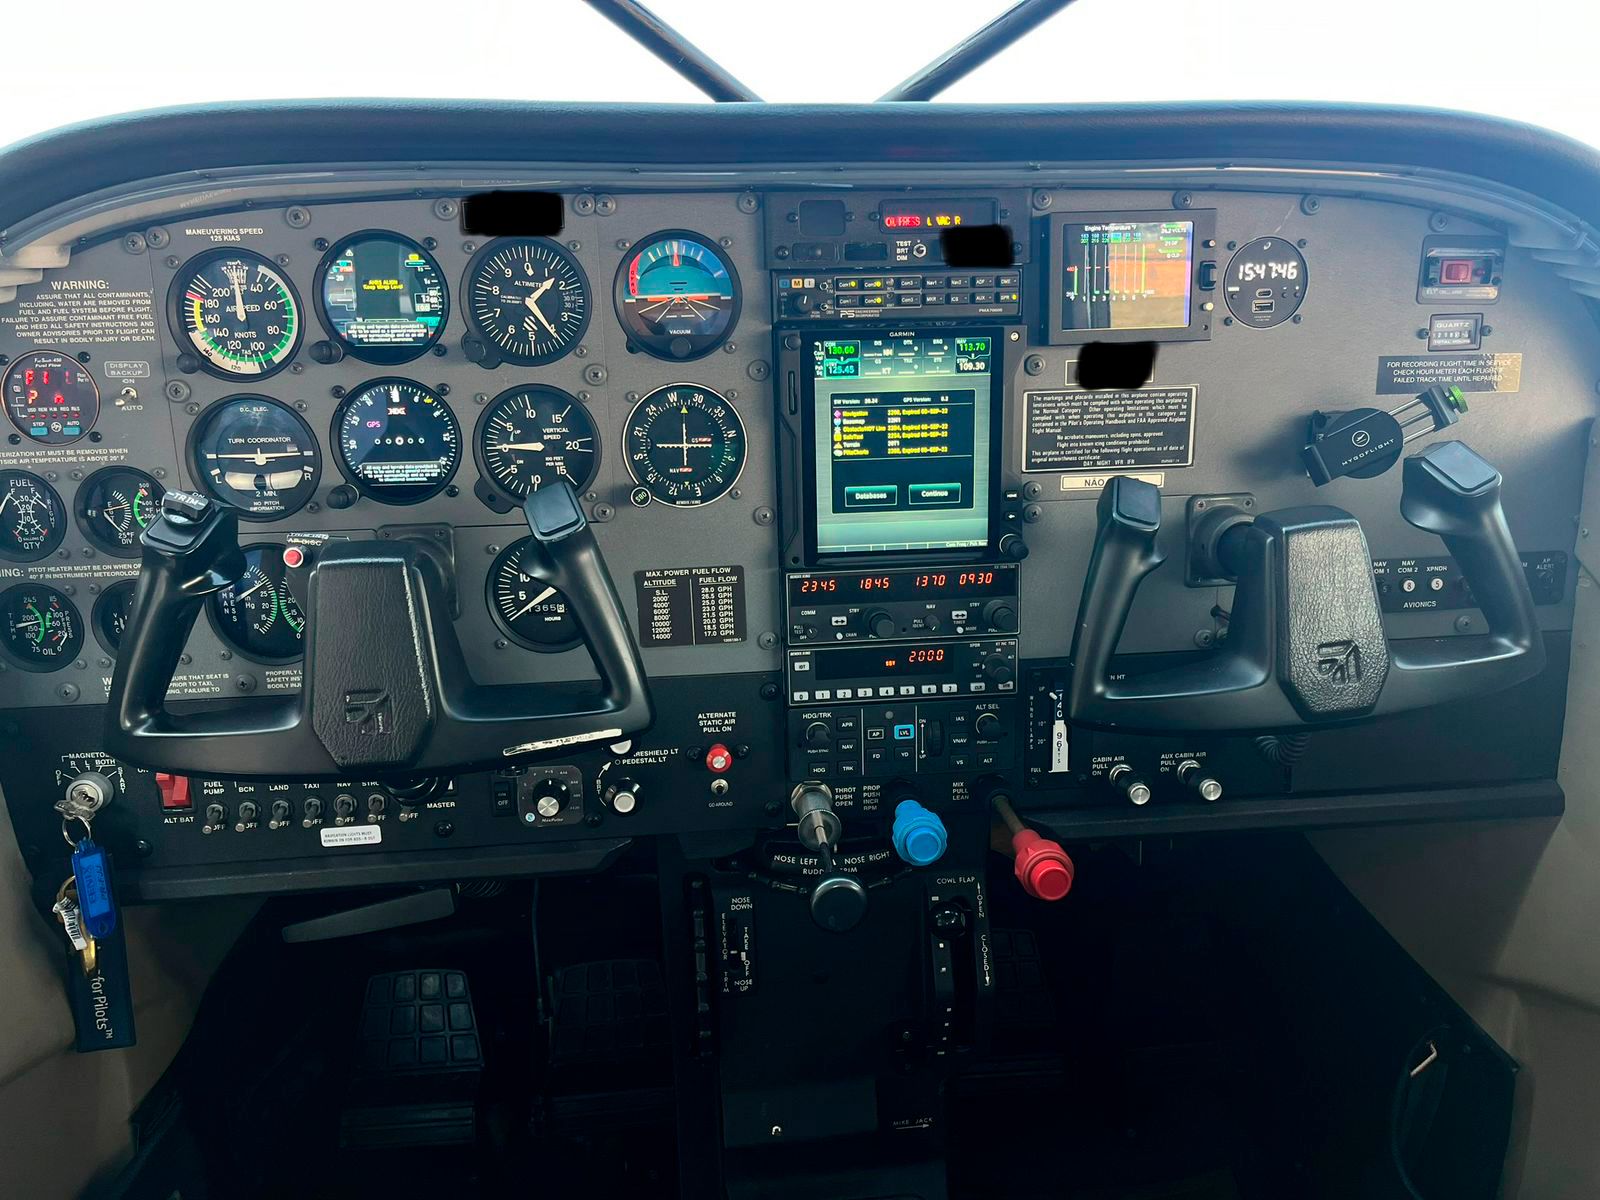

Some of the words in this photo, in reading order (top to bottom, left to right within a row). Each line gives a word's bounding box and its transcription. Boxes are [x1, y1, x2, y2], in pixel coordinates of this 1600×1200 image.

[505, 268, 512, 278] 9
[51, 280, 109, 290] WARNING:
[250, 284, 263, 292] 40
[559, 281, 566, 290] 2
[212, 288, 230, 297] 200
[492, 286, 499, 295] 8
[205, 300, 219, 308] 180
[264, 301, 277, 310] 60
[494, 309, 500, 317] 7
[561, 312, 568, 321] 3
[205, 314, 220, 323] 160
[213, 328, 229, 337] 140
[267, 326, 279, 334] 80
[508, 325, 515, 334] 6
[528, 332, 535, 340] 5
[227, 341, 241, 349] 120
[250, 342, 265, 350] 100
[526, 409, 536, 418] 10
[552, 414, 562, 423] 15
[506, 423, 513, 431] 5
[566, 441, 579, 450] 20
[1341, 438, 1395, 466] MYGOFLIGHT
[510, 465, 517, 473] 5
[556, 466, 567, 475] 15
[531, 475, 541, 484] 10
[173, 493, 200, 505] TRIM
[860, 577, 889, 589] 1845
[916, 575, 945, 587] 1370
[960, 573, 993, 585] 0930
[802, 580, 836, 593] 2345
[909, 649, 944, 662] 2000
[774, 855, 796, 864] NOSE
[844, 856, 867, 864] NOSE
[869, 851, 890, 861] RIGHT
[91, 977, 105, 994] for
